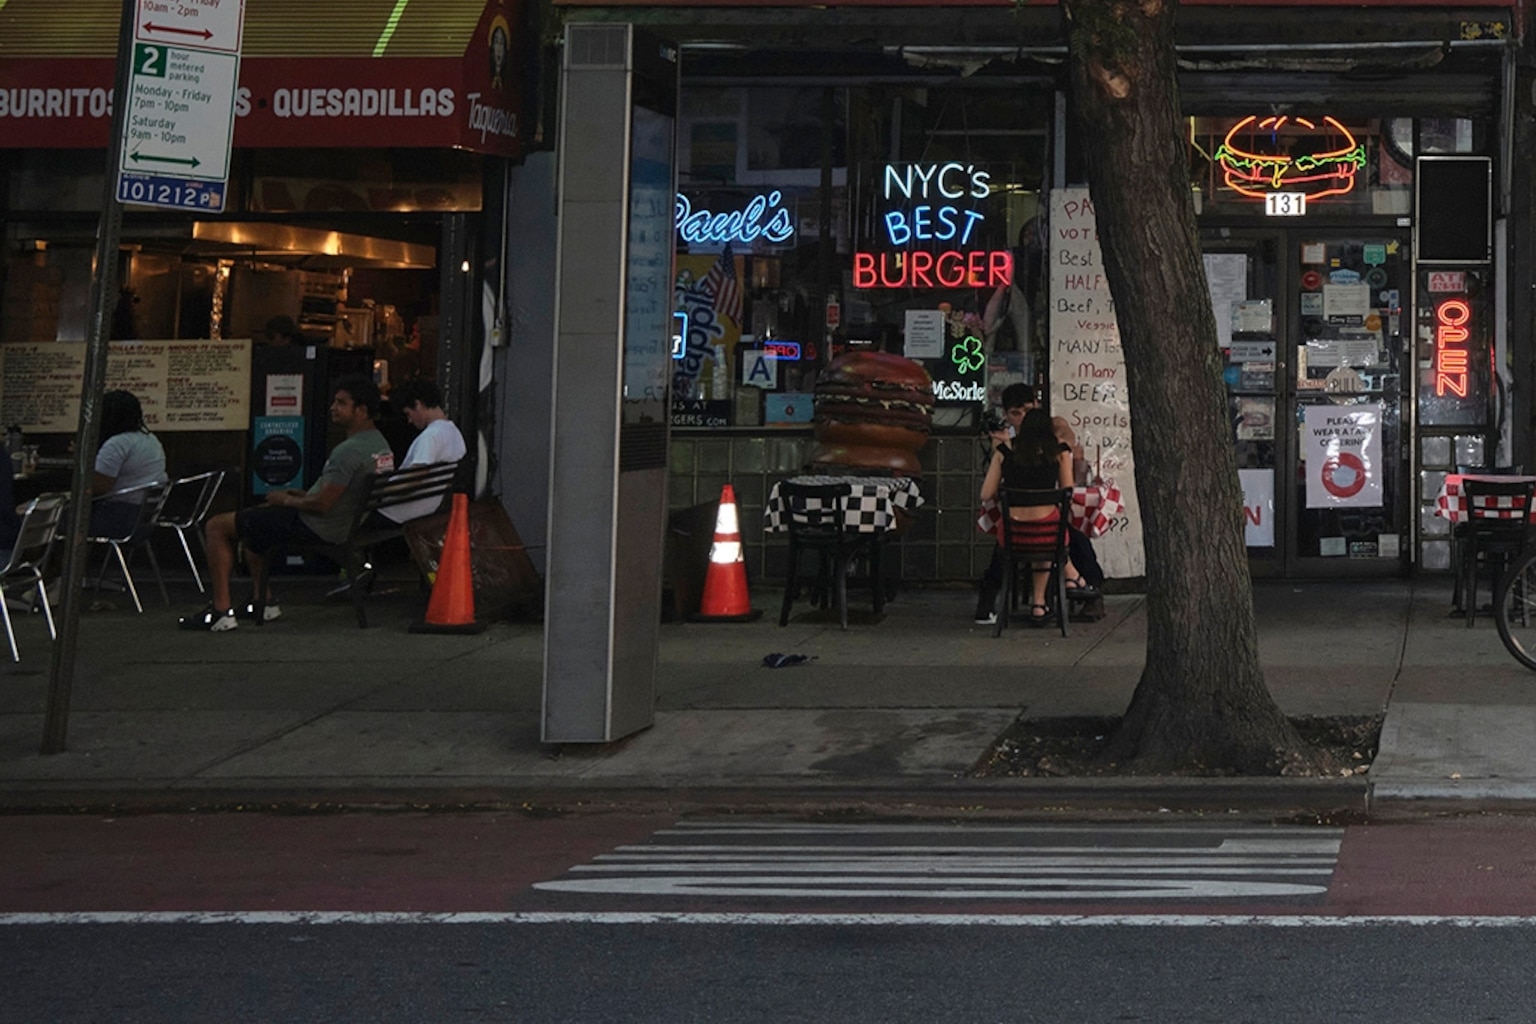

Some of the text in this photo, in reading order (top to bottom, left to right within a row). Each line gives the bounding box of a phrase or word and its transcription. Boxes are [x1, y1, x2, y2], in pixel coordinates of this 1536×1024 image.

[143, 0, 199, 18] 10am 2pm
[141, 46, 160, 74] 2
[171, 51, 189, 61] hour
[170, 62, 204, 73] metered
[169, 72, 200, 84] parking
[135, 83, 212, 104] Monday Friday
[134, 97, 189, 113] 7pm 10pm
[273, 88, 455, 119] QUESADILLAS
[132, 114, 176, 131] Saturday
[130, 129, 187, 144] 9am 10pm
[885, 163, 990, 200] NYC's
[122, 181, 197, 206] 101212
[1270, 196, 1305, 214] 131
[676, 190, 795, 243] Paul's
[885, 205, 985, 245] BEST
[1059, 249, 1093, 267] Best
[854, 250, 1014, 288] BURGER
[1058, 339, 1101, 354] MANY
[1436, 300, 1470, 397] OPEN
[748, 356, 771, 381] A
[1078, 362, 1117, 379] Many
[1070, 409, 1128, 427] Sports
[1327, 417, 1358, 425] PLEAS
[1313, 428, 1340, 436] WEAR
[1342, 428, 1350, 436] A
[1320, 439, 1369, 447] CERIN
